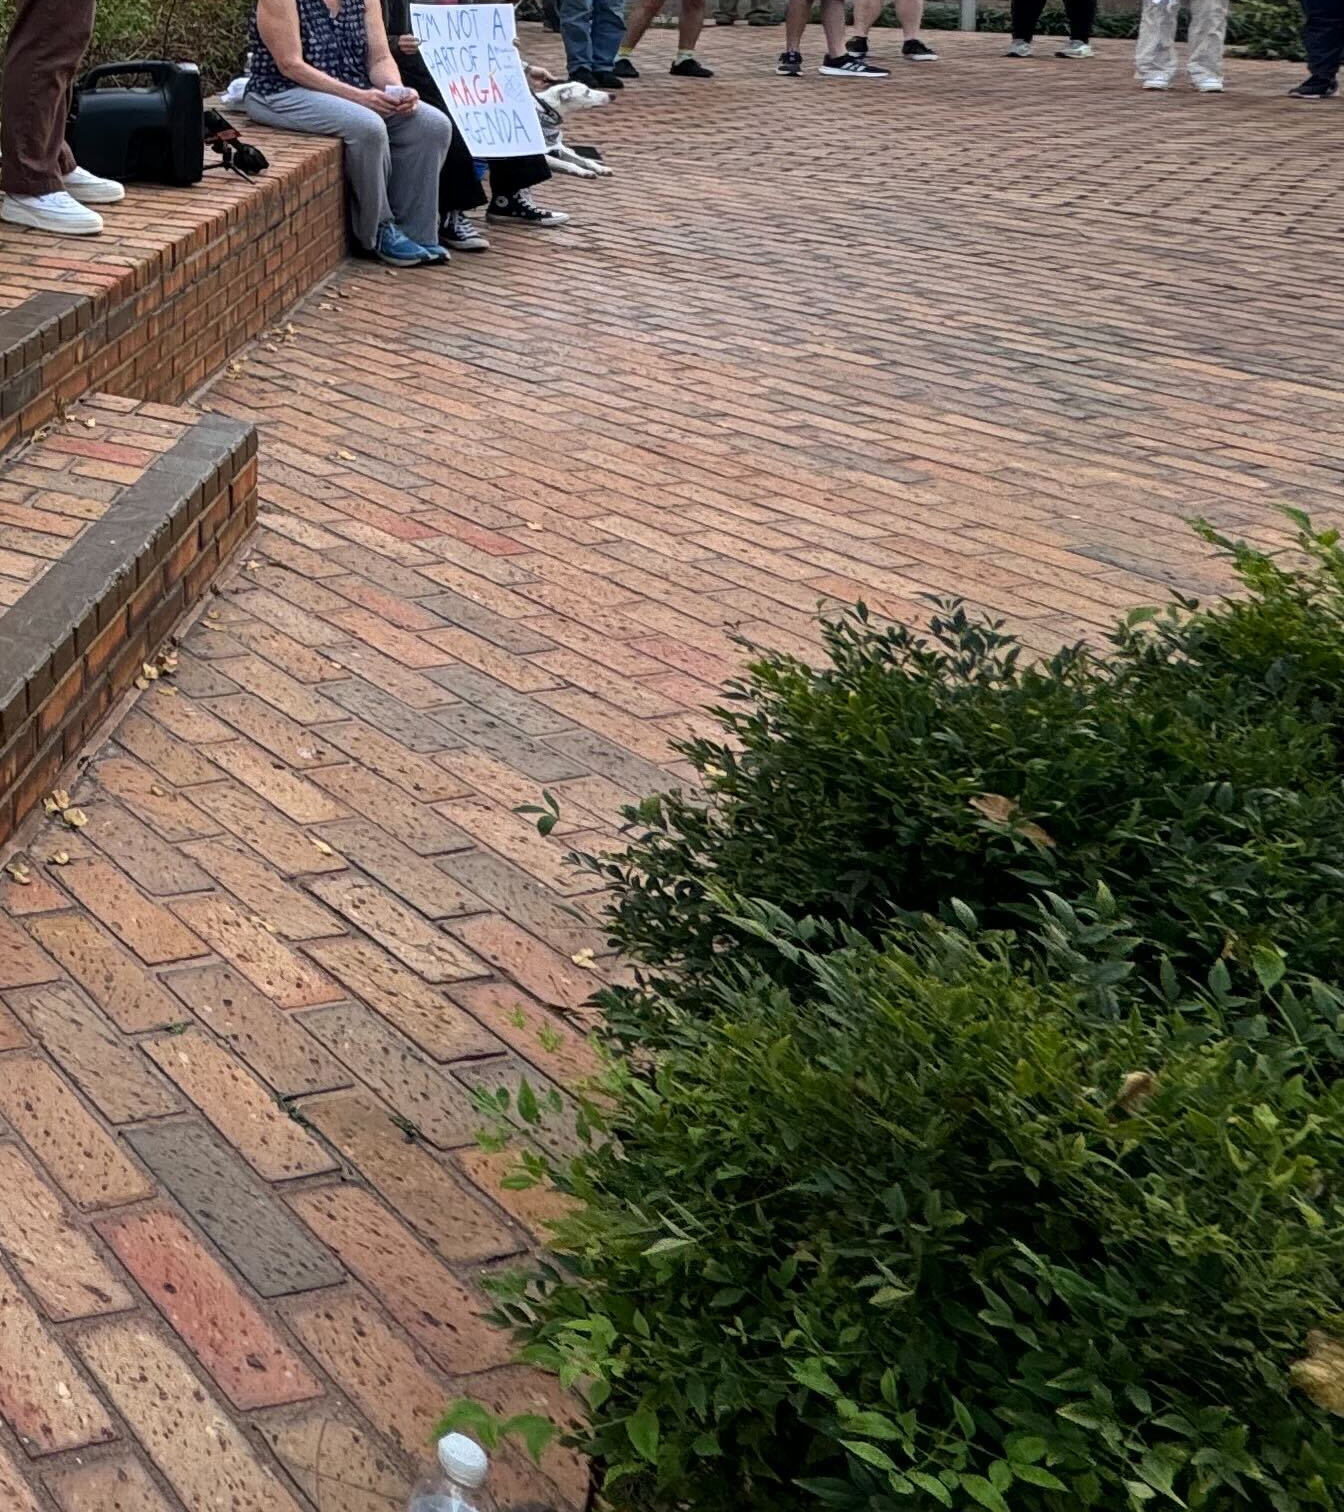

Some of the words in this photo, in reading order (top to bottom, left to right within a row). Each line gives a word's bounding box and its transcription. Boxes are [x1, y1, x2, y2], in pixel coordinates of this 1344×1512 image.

[413, 12, 441, 43] I'M
[447, 8, 479, 40] NOT
[492, 7, 507, 40] A
[459, 44, 479, 73] OF
[487, 43, 502, 73] A
[447, 74, 505, 109] MAGA
